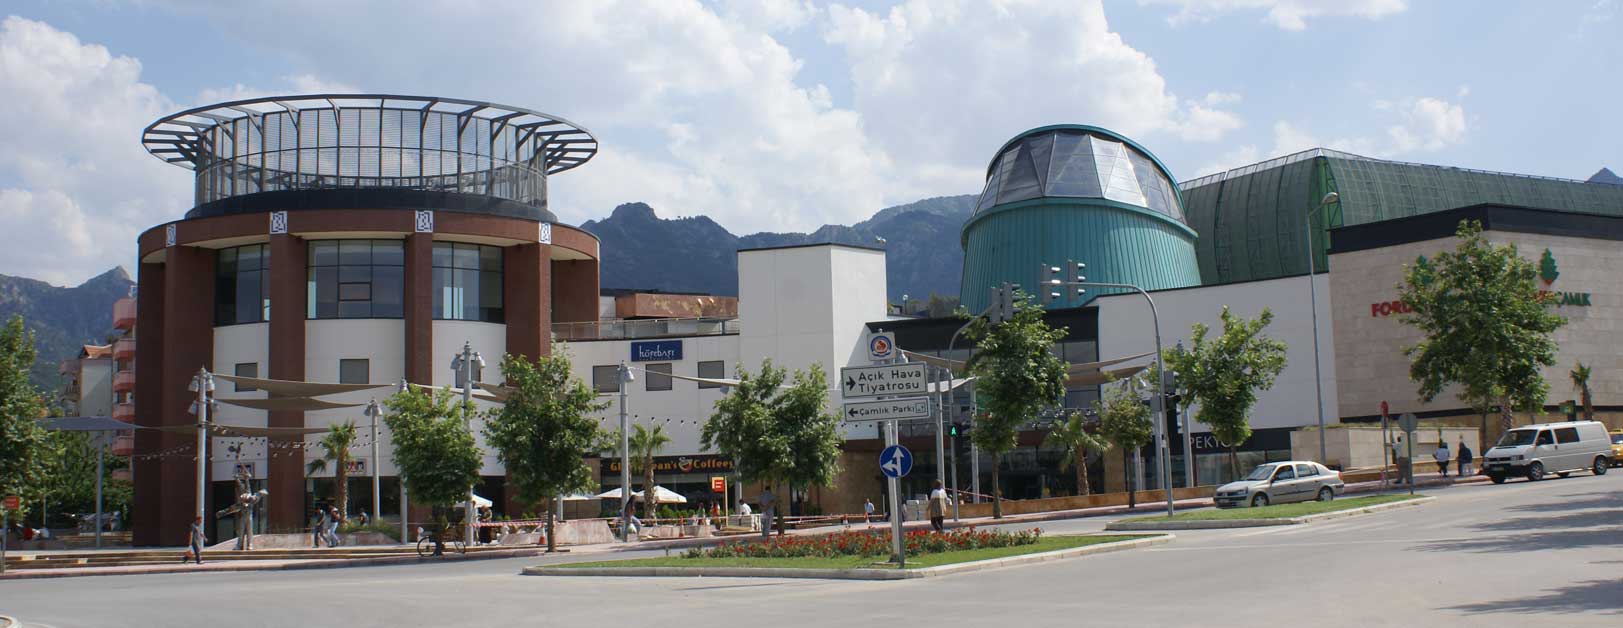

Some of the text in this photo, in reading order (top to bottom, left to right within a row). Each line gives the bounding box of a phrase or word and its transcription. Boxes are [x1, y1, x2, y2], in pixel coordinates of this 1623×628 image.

[858, 369, 922, 382] Açık Hava
[858, 382, 920, 394] Tiyatrosu
[859, 405, 915, 417] Çamlık Parkı
